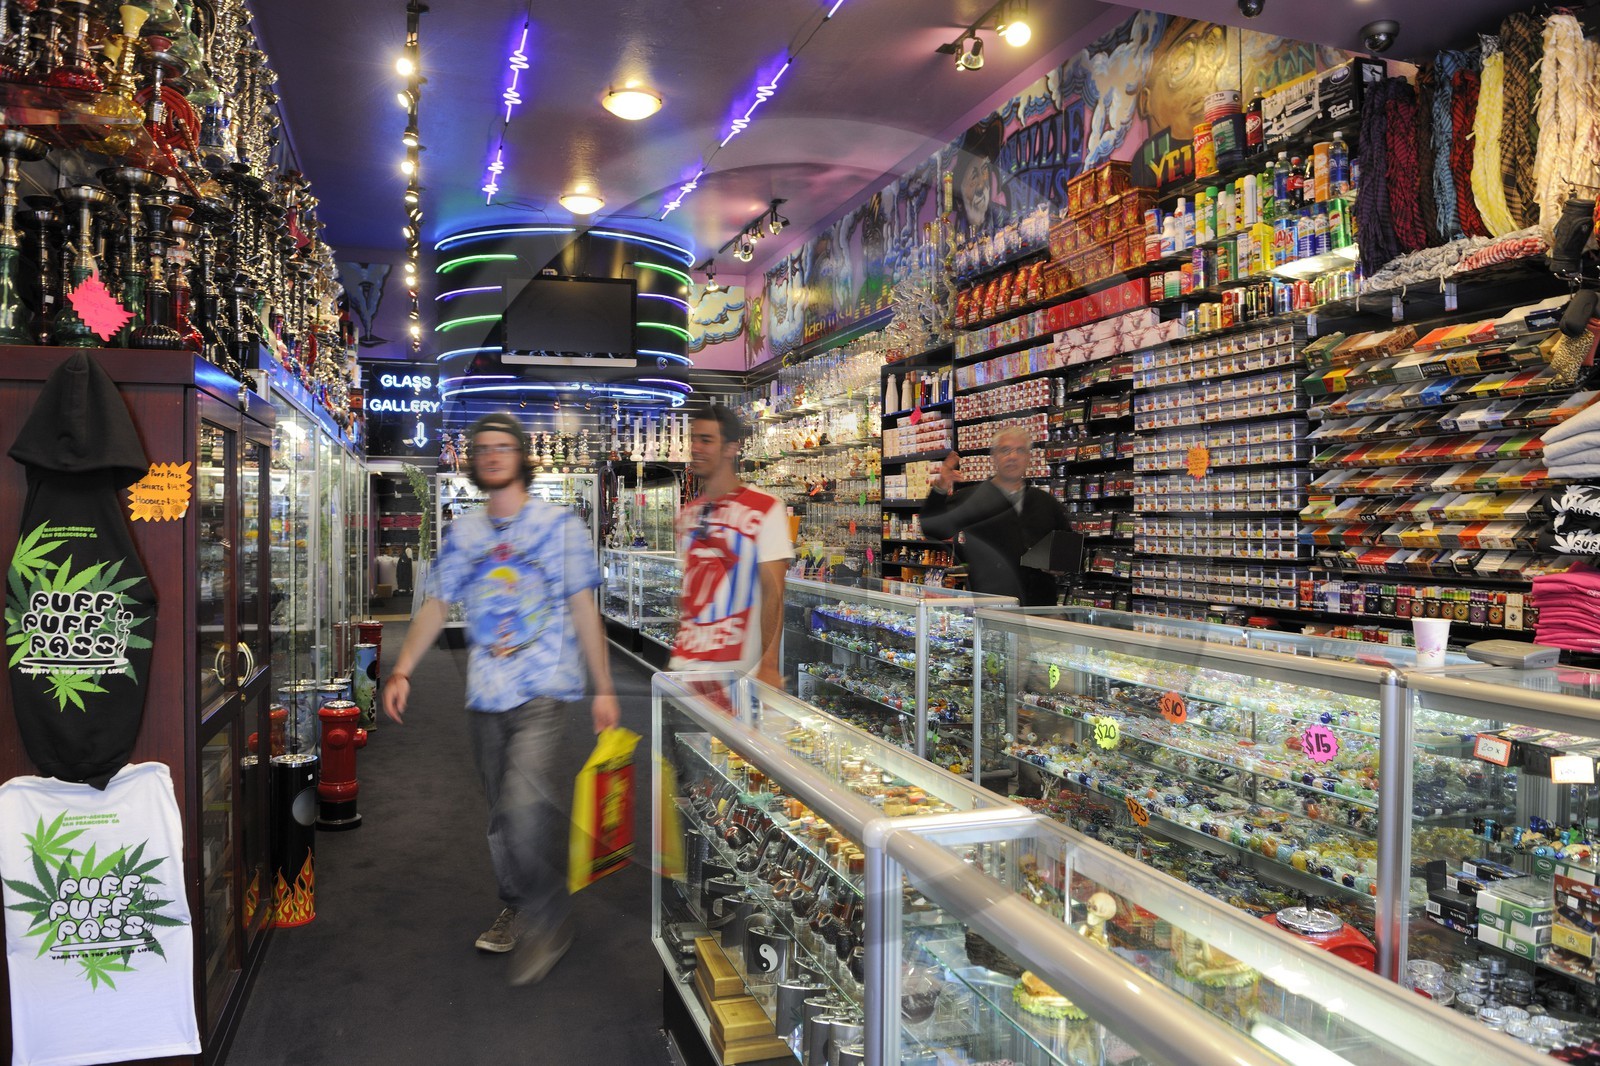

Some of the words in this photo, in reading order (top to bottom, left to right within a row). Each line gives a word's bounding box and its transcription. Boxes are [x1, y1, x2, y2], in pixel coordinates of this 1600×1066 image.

[380, 374, 432, 389] GLASS
[369, 398, 440, 413] GALLERY
[1573, 539, 1600, 550] PUF
[31, 591, 115, 614] PUFF
[22, 613, 104, 635] PUFF
[29, 634, 117, 658] PASS
[1163, 698, 1182, 716] $10
[1097, 724, 1116, 740] $20
[1305, 734, 1331, 754] $15
[1481, 743, 1493, 752] 20
[59, 874, 142, 900] PUFF
[49, 896, 132, 921] PUFF
[57, 915, 145, 941] PASS
